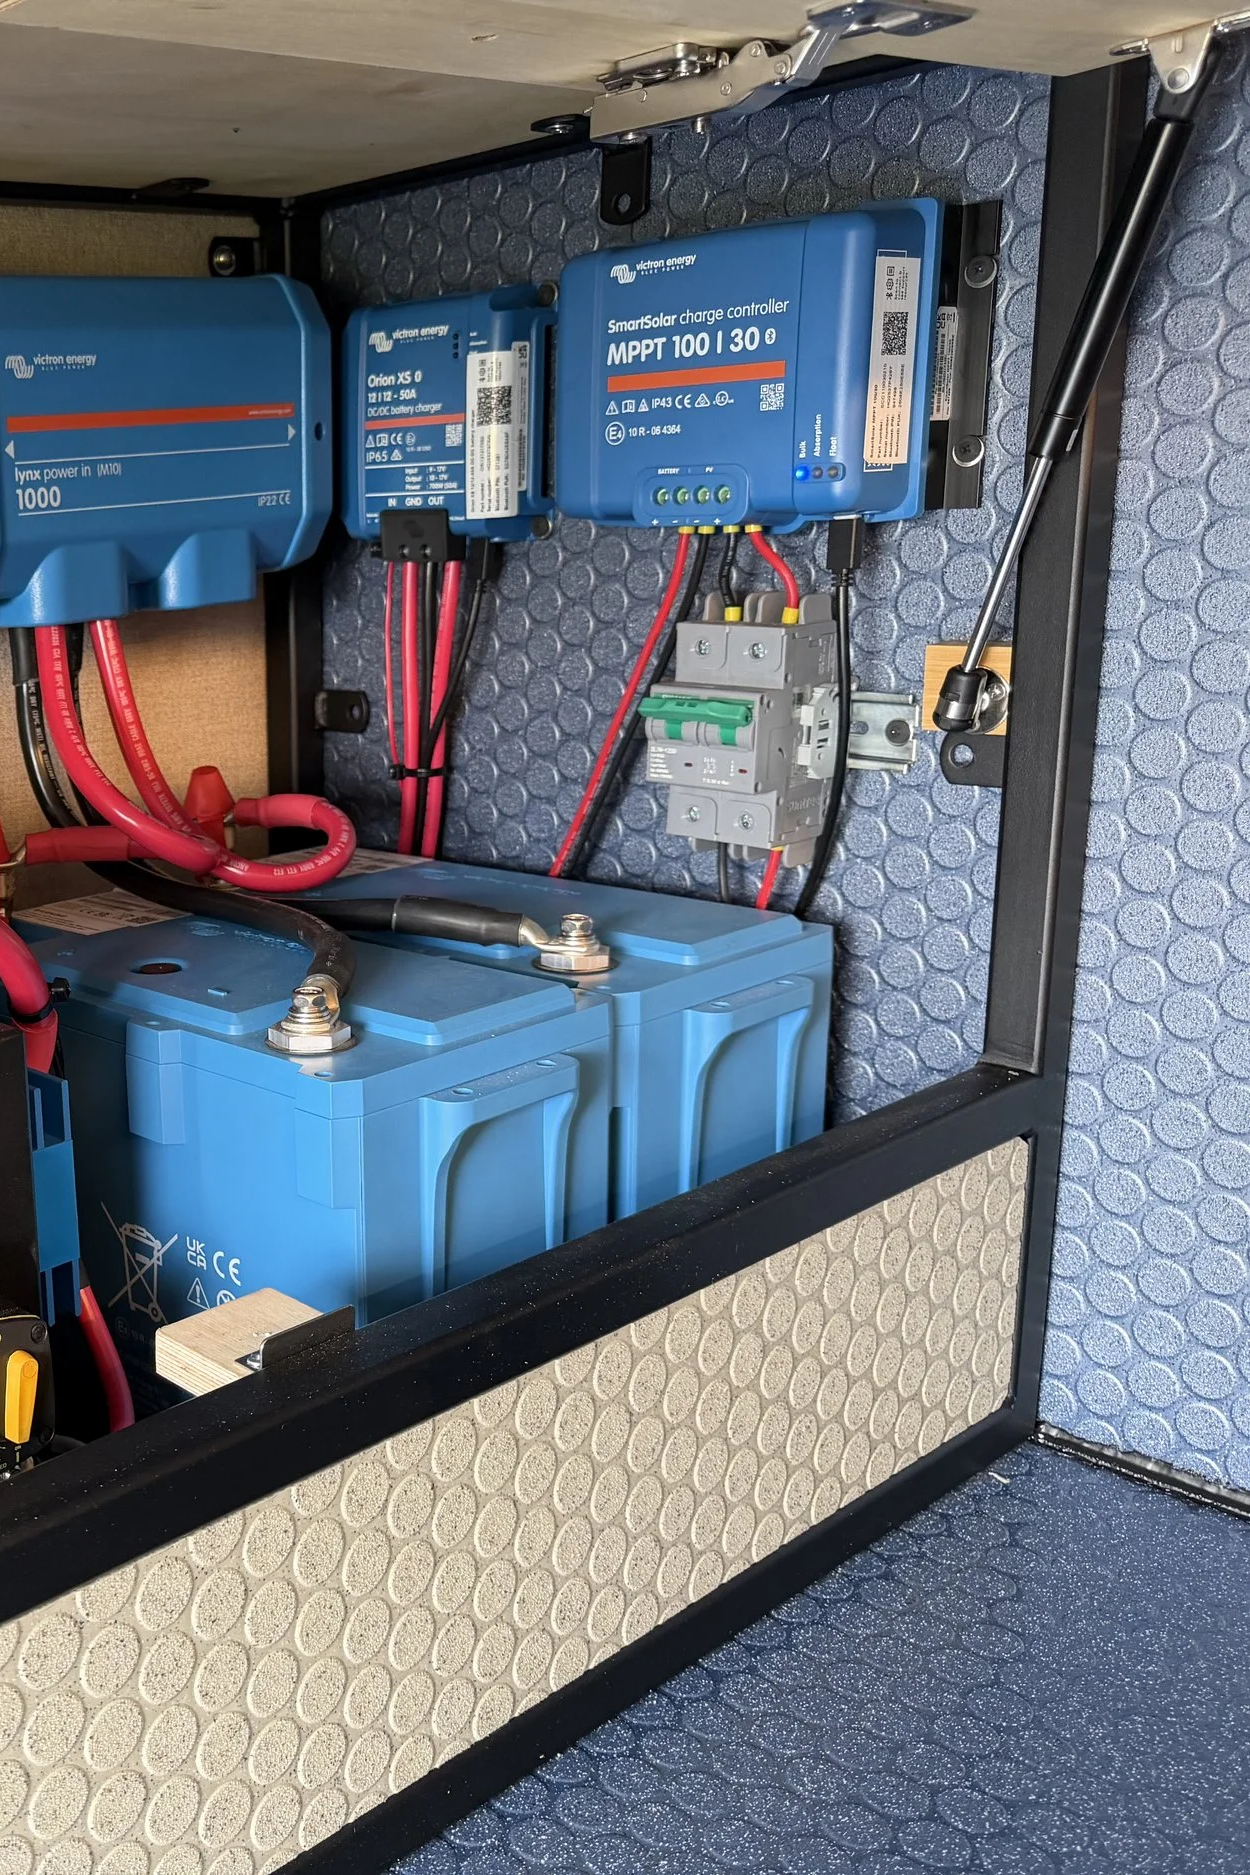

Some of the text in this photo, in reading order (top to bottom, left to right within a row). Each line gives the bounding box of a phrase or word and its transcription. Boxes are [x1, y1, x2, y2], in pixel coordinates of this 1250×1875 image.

[636, 254, 696, 271] victron energy
[608, 298, 789, 334] SmartSolar charge controller
[392, 324, 449, 339] victron energy
[607, 337, 667, 366] MPPT
[672, 332, 710, 359] 100
[729, 326, 760, 352] 30
[33, 353, 97, 367] victron energy
[368, 373, 395, 388] Orion
[397, 371, 413, 384] XS
[398, 388, 417, 400] 50A
[391, 405, 414, 416] battery
[415, 403, 443, 414] charger
[651, 397, 672, 409] IP43
[628, 427, 637, 437] 10
[638, 426, 645, 436] R
[813, 413, 822, 456] Absorption
[798, 440, 807, 458] Bulk
[828, 436, 837, 457] Float
[366, 451, 388, 463] IP65
[14, 463, 122, 485] lynx power in (M10)
[657, 467, 680, 475] BATTERY
[15, 486, 61, 510] 1000
[257, 495, 277, 508] IP22
[387, 496, 445, 507] IN GND OUT
